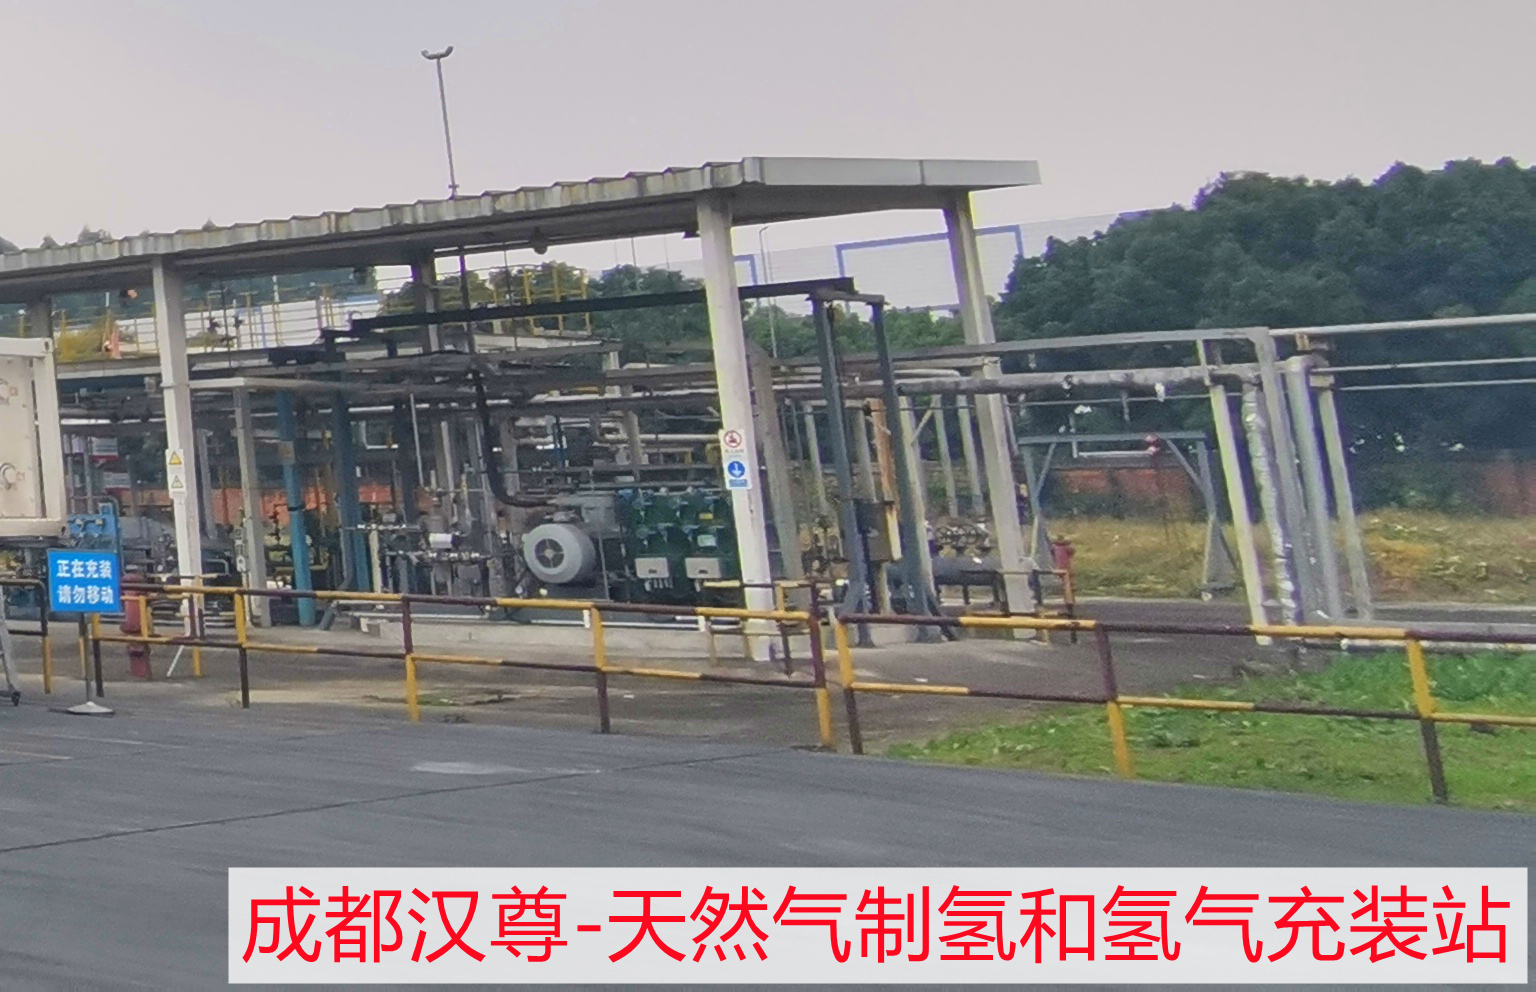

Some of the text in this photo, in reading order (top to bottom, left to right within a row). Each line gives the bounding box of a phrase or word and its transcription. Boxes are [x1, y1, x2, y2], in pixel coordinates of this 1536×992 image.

[56, 559, 112, 579] 正在充装
[57, 584, 114, 604] 请勿移动
